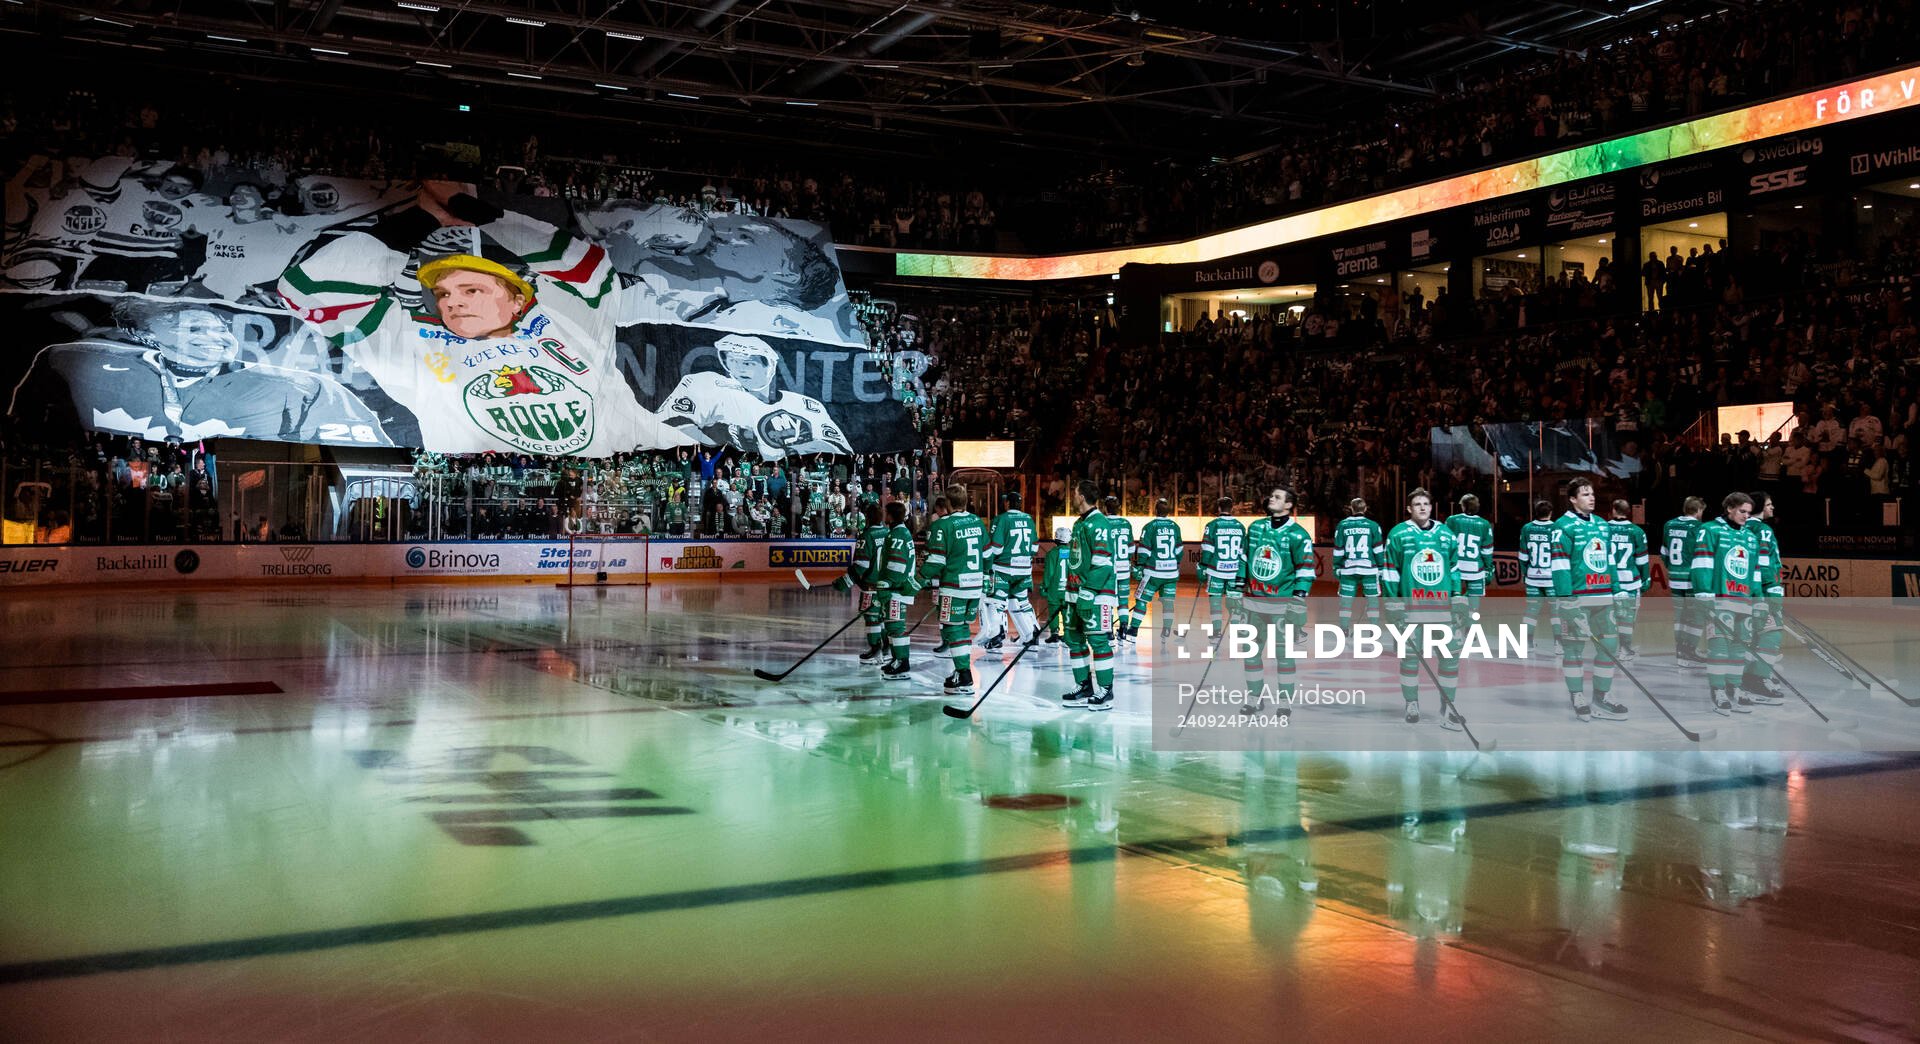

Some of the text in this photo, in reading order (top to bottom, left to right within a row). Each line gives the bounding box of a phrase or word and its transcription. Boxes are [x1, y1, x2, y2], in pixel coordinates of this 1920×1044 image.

[1816, 88, 1875, 120] FÖR
[1758, 136, 1823, 162] swedlog
[1748, 165, 1808, 195] SSE
[1708, 189, 1723, 205] Bil
[1487, 229, 1510, 242] JOA
[1195, 265, 1253, 283] Backahill
[1337, 256, 1378, 276] arema
[486, 401, 587, 442] RÖGLE
[936, 530, 943, 541] 5
[956, 527, 983, 539] CLAESSO
[1010, 528, 1032, 554] 75
[1095, 528, 1108, 541] 24
[1864, 536, 1897, 544] NOVUM
[891, 538, 904, 549] 77
[1156, 536, 1175, 559] 51
[1345, 535, 1369, 559] 44
[1669, 538, 1683, 565] 8
[429, 550, 500, 568] Brinova
[540, 547, 592, 558] Stefan
[683, 546, 715, 558] EURO
[789, 550, 850, 564] JINERT
[966, 537, 980, 570] 5
[1527, 542, 1552, 568] 36
[97, 555, 167, 570] Backahill
[262, 564, 331, 576] TRELLEBORG
[608, 558, 627, 568] AB
[675, 556, 722, 569] JACKPOT
